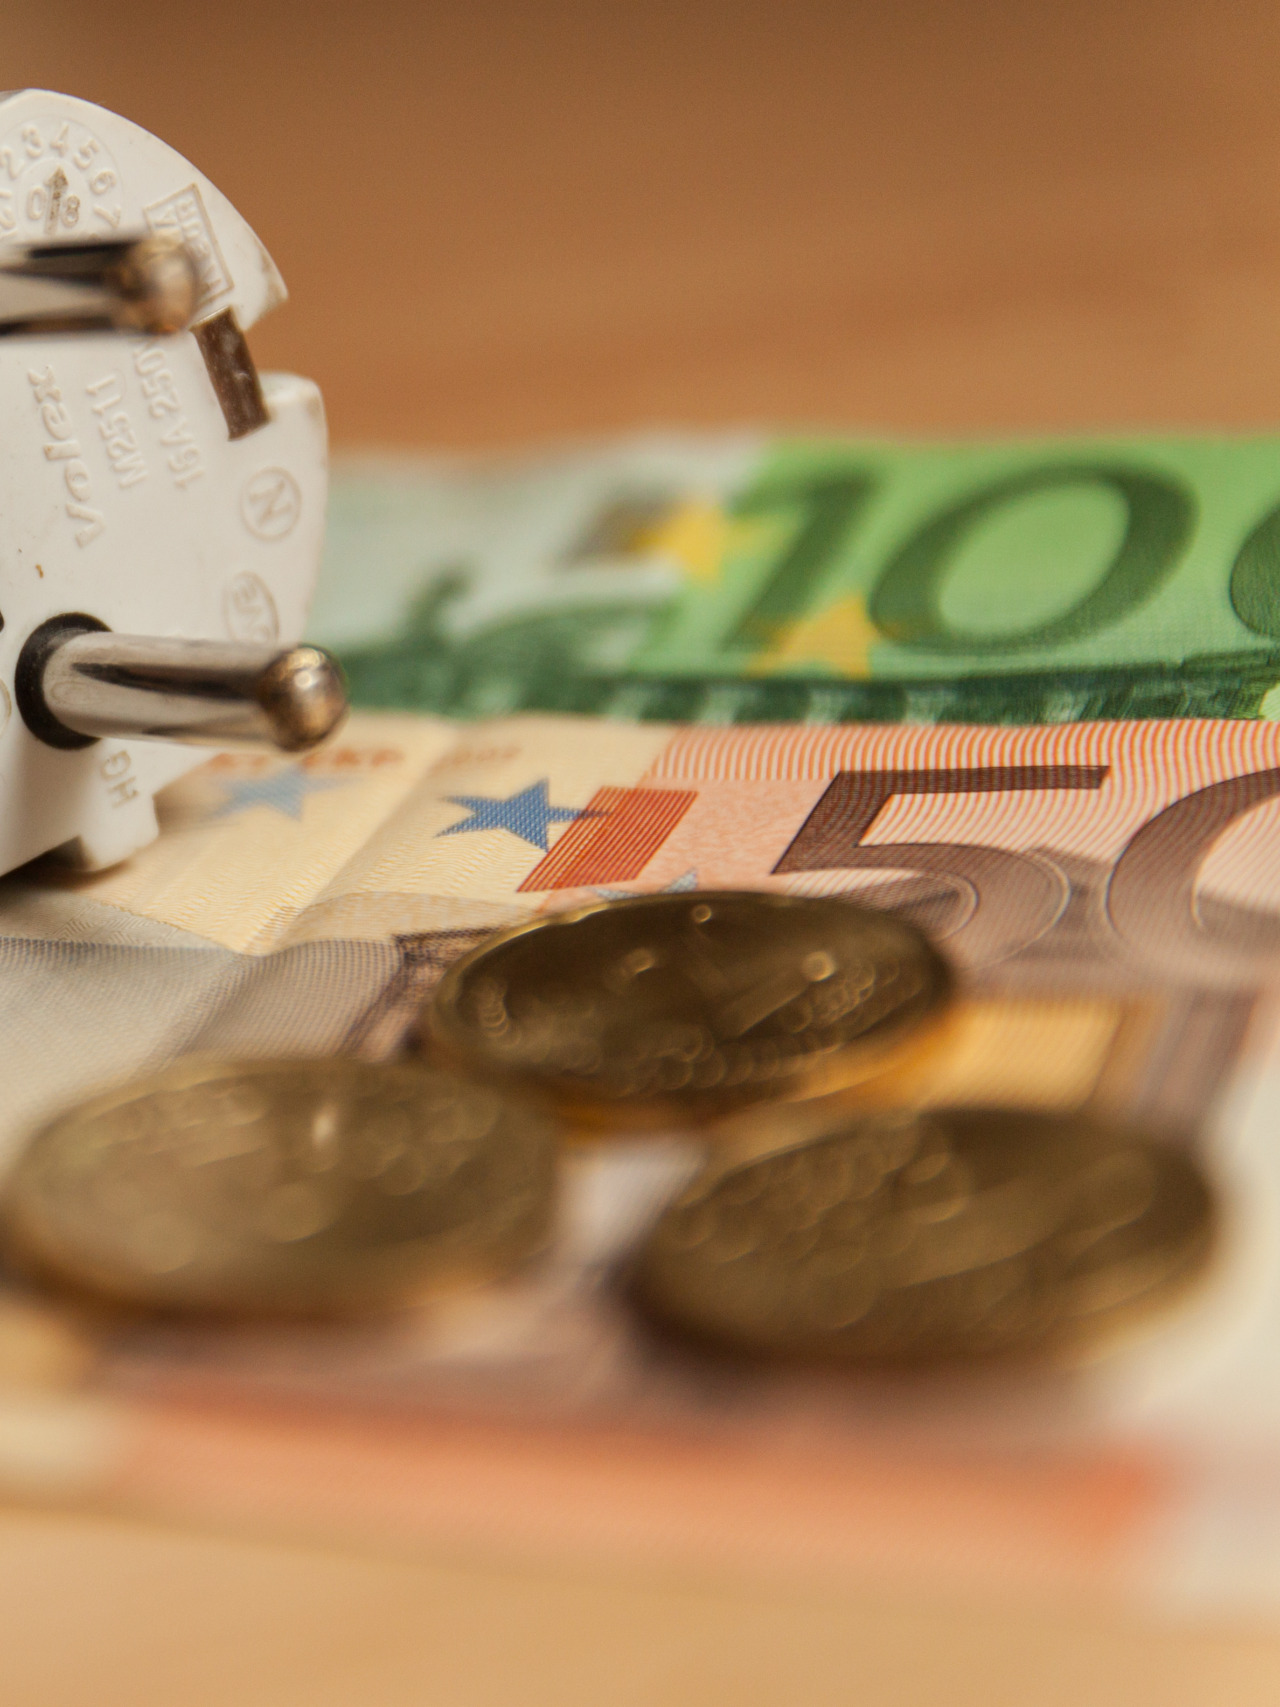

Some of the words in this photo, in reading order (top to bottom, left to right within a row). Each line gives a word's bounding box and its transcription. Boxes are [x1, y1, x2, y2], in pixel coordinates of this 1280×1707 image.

[27, 364, 105, 548] Volex
[85, 373, 150, 490] M2511
[159, 418, 206, 491] 16A
